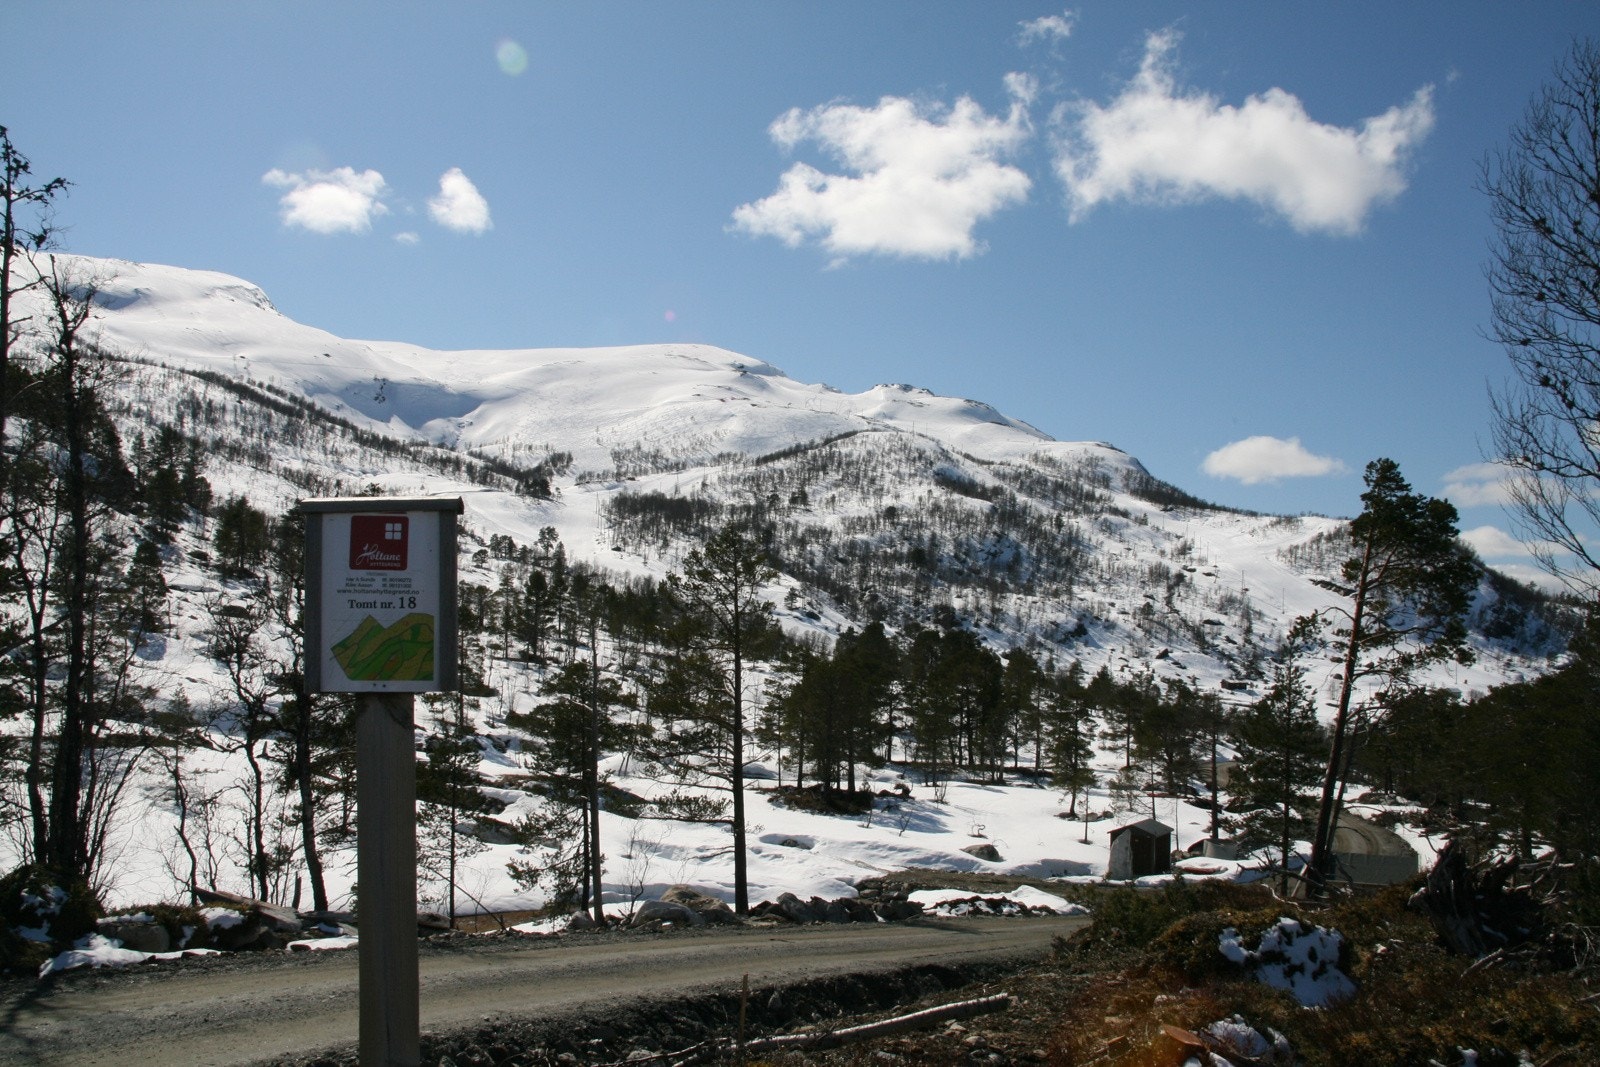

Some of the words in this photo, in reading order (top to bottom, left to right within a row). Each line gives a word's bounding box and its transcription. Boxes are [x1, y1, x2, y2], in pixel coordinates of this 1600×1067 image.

[355, 543, 401, 565] Holtane
[347, 599, 377, 609] Tomt
[399, 596, 417, 609] 18
